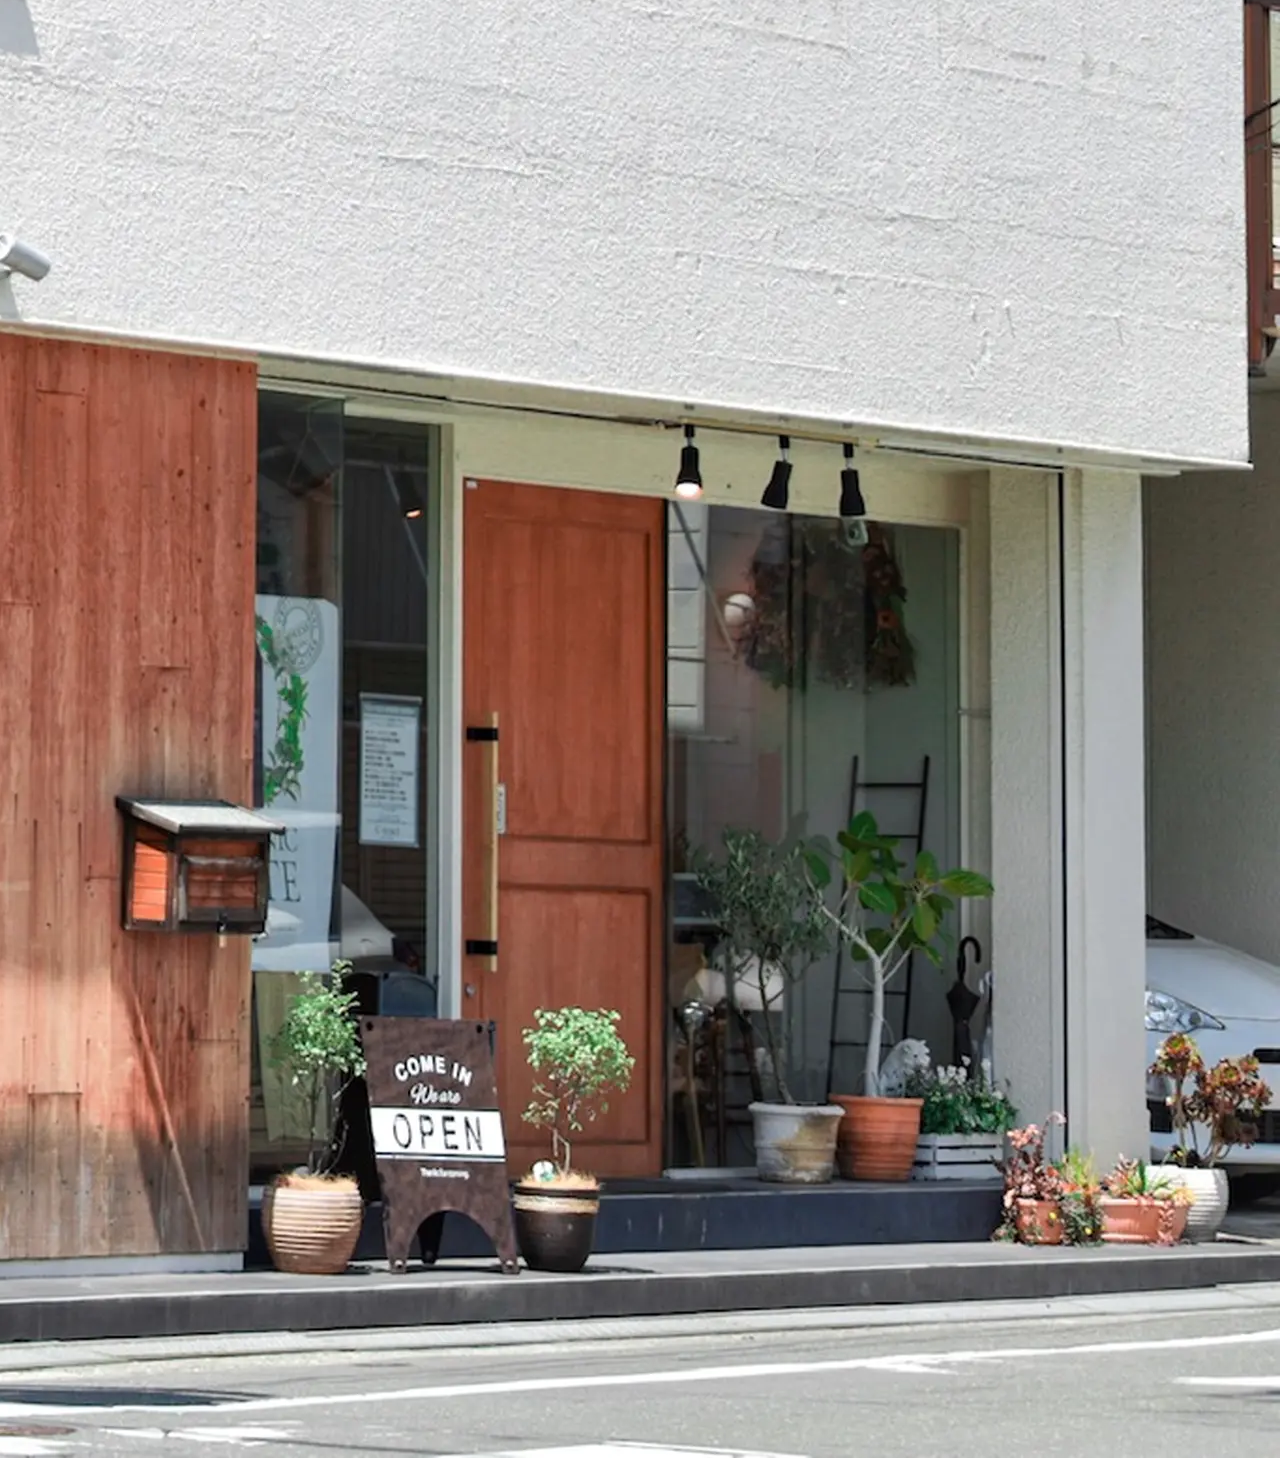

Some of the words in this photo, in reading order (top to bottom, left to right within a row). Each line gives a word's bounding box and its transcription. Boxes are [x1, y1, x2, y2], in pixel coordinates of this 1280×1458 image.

[394, 1054, 446, 1082] COME
[451, 1062, 473, 1087] IN
[393, 1113, 483, 1151] OPEN
